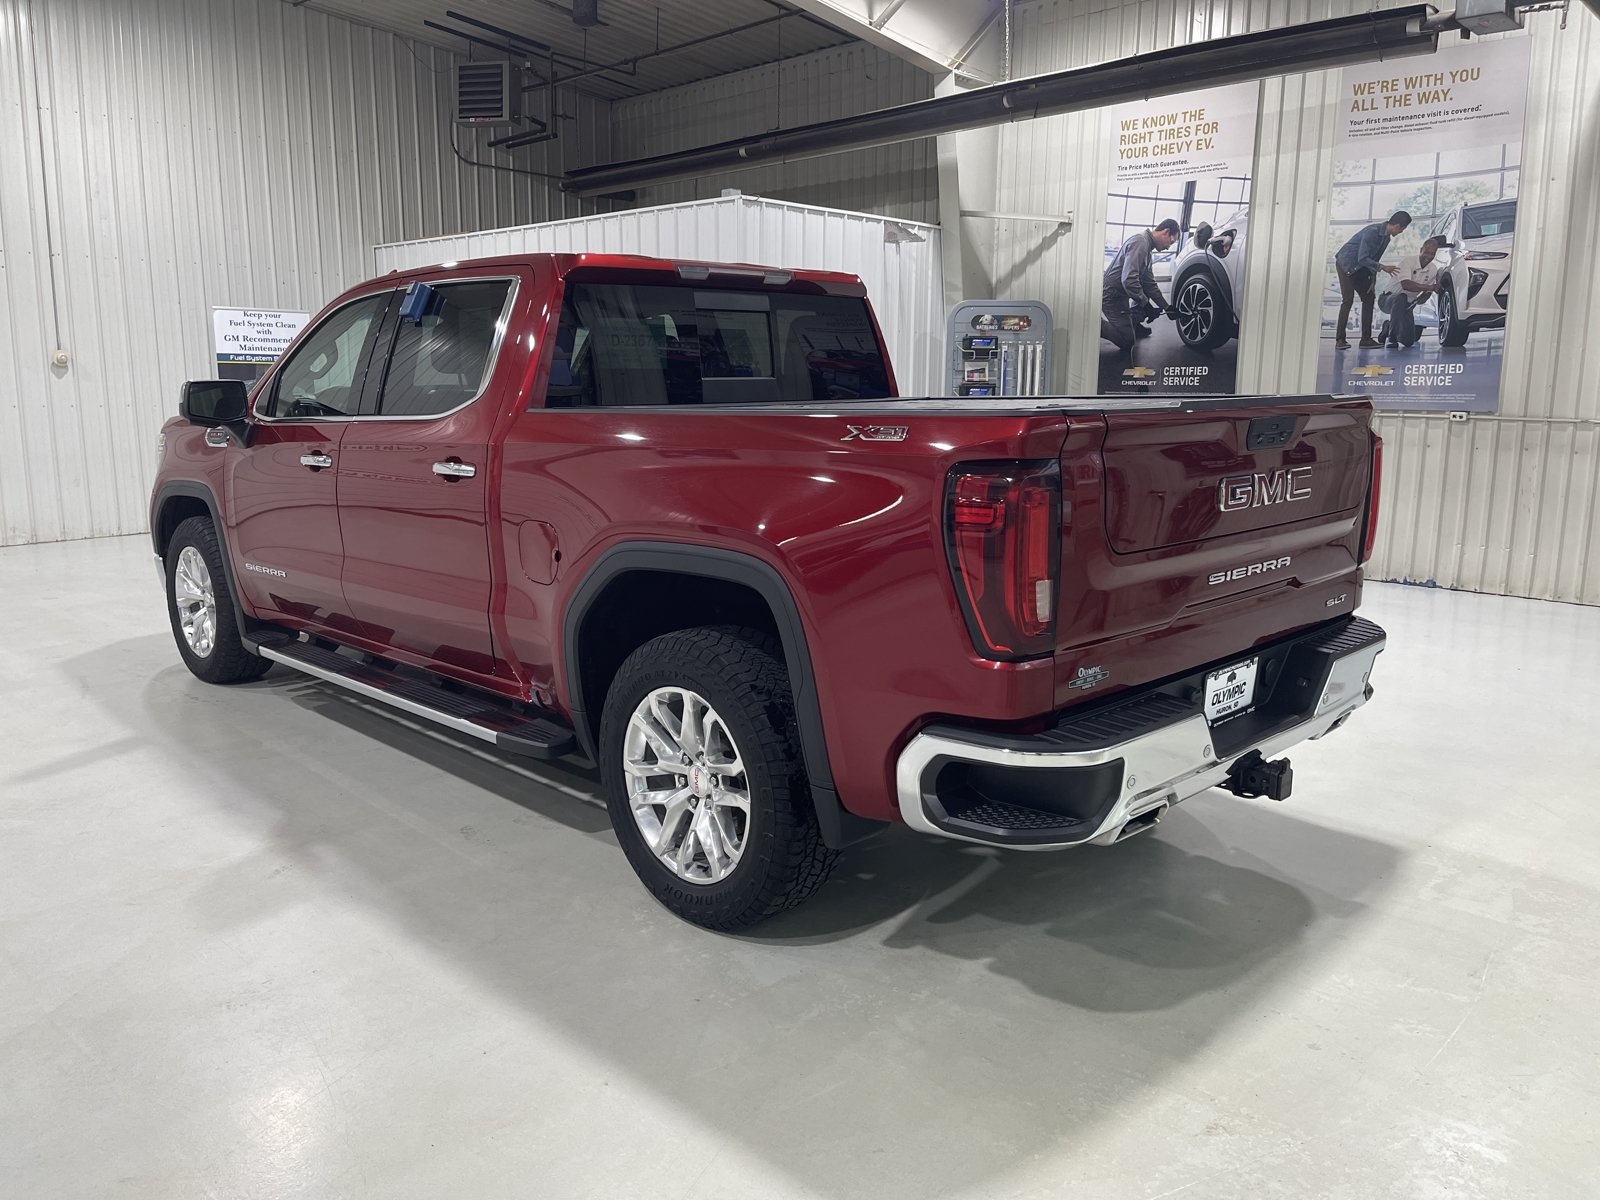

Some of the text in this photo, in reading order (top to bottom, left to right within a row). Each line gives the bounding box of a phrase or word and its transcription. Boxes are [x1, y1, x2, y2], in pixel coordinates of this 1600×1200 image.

[1352, 67, 1481, 96] WE'RE WITH YOU
[1351, 88, 1453, 112] ALL THE WAY.
[1120, 108, 1205, 131] WE KNOW THE
[1382, 113, 1425, 123] maintenance
[1120, 121, 1219, 146] RIGHT TIRES FOR
[1119, 137, 1214, 160] YOUR CHEVY EV.
[1160, 159, 1189, 167] Guarantee.
[243, 311, 262, 319] Keep
[224, 334, 239, 342] GM
[1163, 366, 1209, 376] CERTIFIED
[1404, 363, 1464, 375] CERTIFIED
[1162, 376, 1200, 386] SERVICE
[1403, 376, 1452, 386] SERVICE
[1218, 466, 1312, 512] GMC
[245, 562, 287, 578] SIERRA
[1208, 556, 1292, 585] SIERRA
[1326, 594, 1347, 607] SLT
[1211, 681, 1247, 706] OLYMPIC
